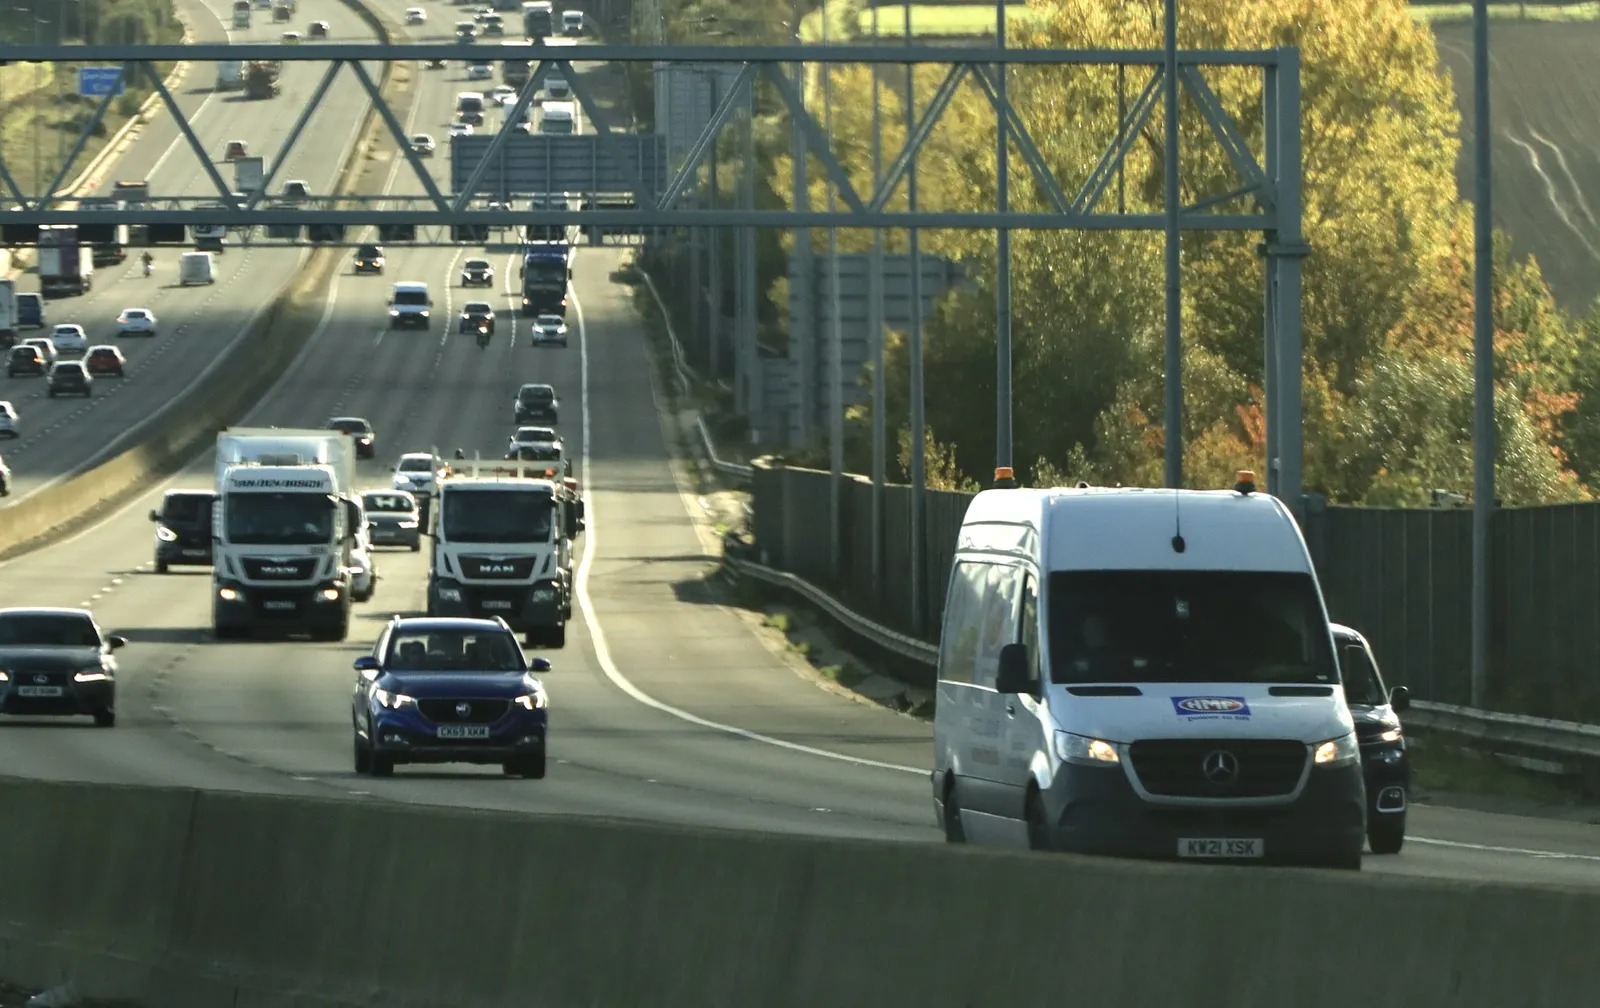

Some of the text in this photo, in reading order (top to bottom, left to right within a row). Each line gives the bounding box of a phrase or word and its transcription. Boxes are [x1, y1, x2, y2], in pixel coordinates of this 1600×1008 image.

[479, 564, 514, 573] MAN
[1187, 840, 1255, 855] KW21 XSK
